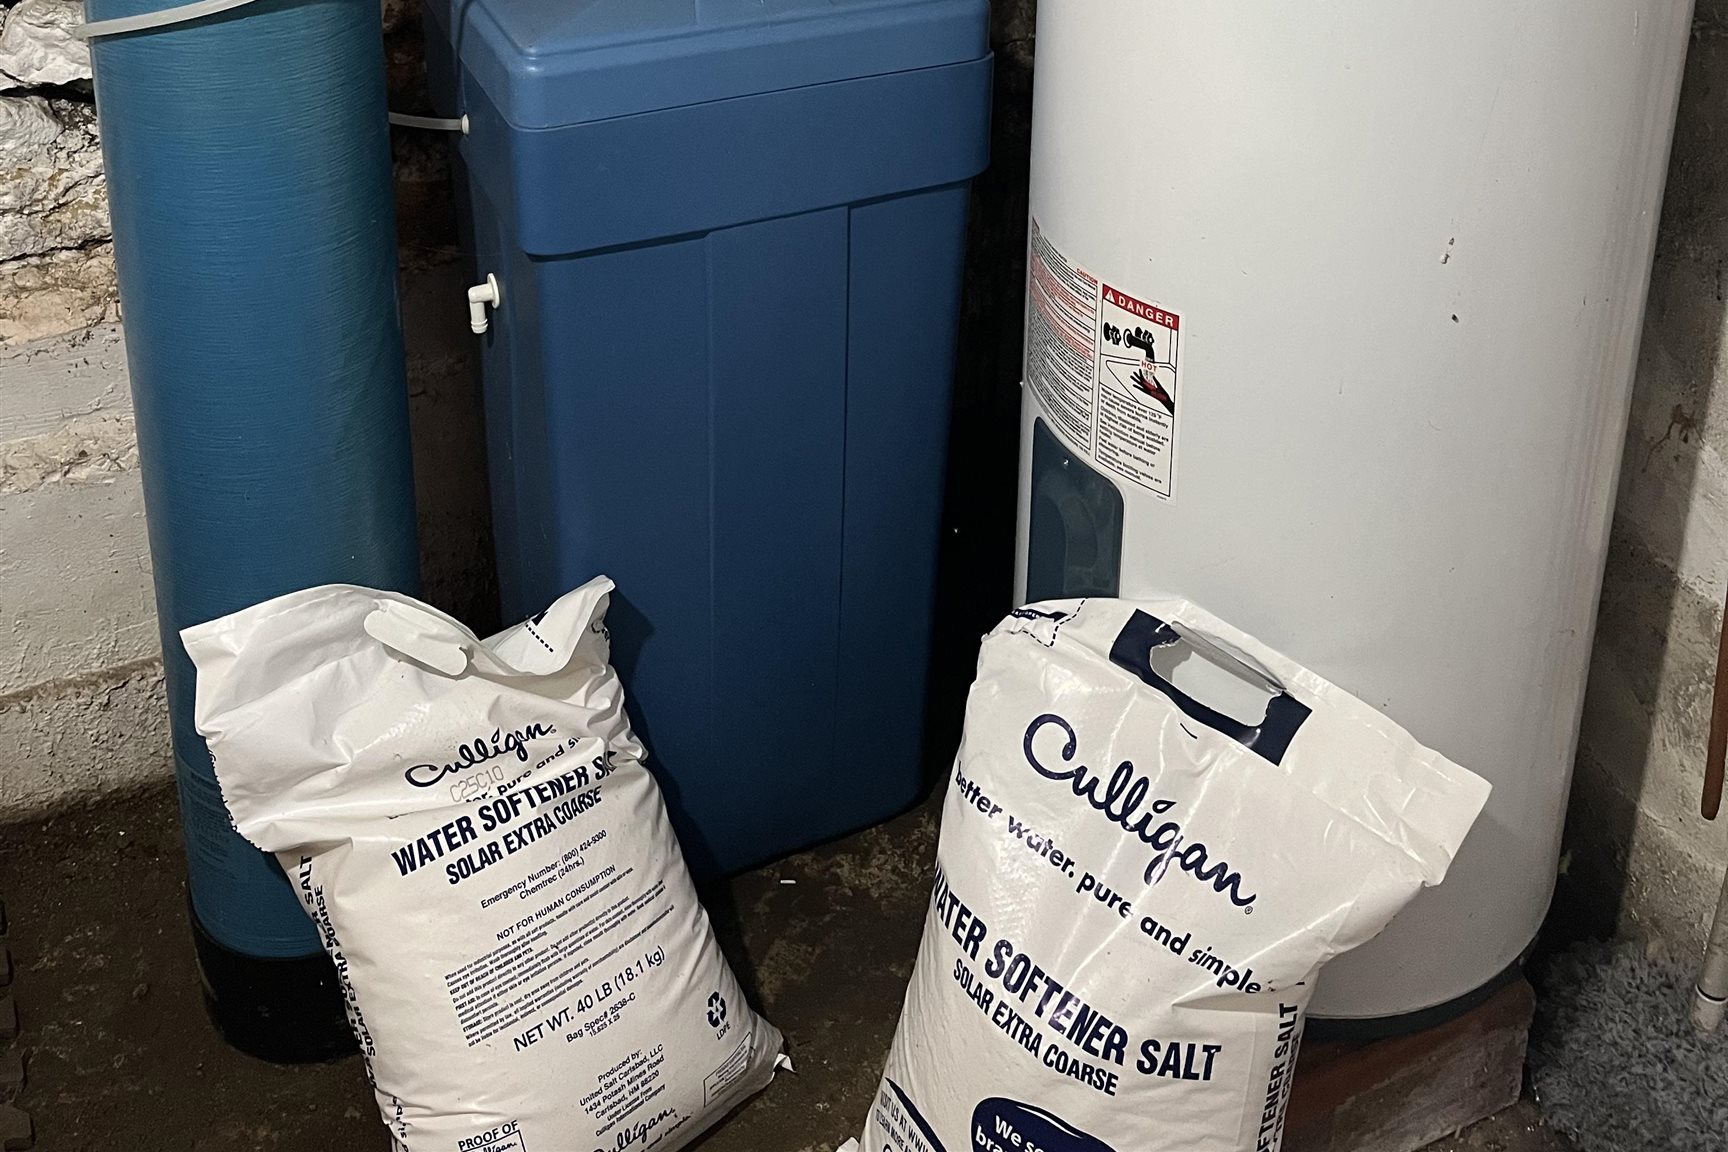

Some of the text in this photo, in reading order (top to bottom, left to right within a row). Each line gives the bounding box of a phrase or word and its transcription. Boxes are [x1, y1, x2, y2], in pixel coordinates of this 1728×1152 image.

[1118, 296, 1174, 326] DANGER
[1142, 360, 1157, 372] HOT
[536, 744, 566, 771] and
[450, 765, 504, 804] C25C10
[1022, 713, 1257, 907] Culligan
[391, 765, 590, 877] WATER SOFTENER
[445, 784, 603, 886] SOLAR EXTRA COARSE
[300, 855, 314, 905] SALT
[480, 878, 527, 909] Emergency
[528, 859, 562, 884] Number:
[561, 847, 580, 867] (800)
[519, 856, 585, 900] Chemtrec (24hrs.)
[954, 760, 1262, 994] better water. pure and simple
[496, 864, 617, 942] NOT FOR HUMAN CONSUMPTION
[512, 945, 667, 1052] NET WT. 40 LB (18.1 kg)
[566, 992, 637, 1044] Bag Spec# 2638-C
[984, 939, 1130, 1066] SOFTENER
[1136, 1039, 1222, 1081] SALT
[352, 1006, 376, 1057] SOLAR
[716, 1020, 732, 1040] LDPE
[953, 957, 1120, 1097] SOLAR EXTRA COARSE
[1274, 1002, 1298, 1059] SALT
[579, 1044, 664, 1107] United Salt Carlsbad, LLC
[584, 1054, 665, 1116] 1434 Potash Mines Road
[597, 1050, 643, 1083] Produced by:
[595, 1096, 629, 1120] Carlsbad,
[628, 1083, 642, 1098] NM
[891, 1102, 900, 1122] US
[899, 1114, 908, 1133] AT
[458, 1128, 500, 1150] PROOF
[502, 1119, 519, 1135] OF
[995, 1114, 1022, 1148] We
